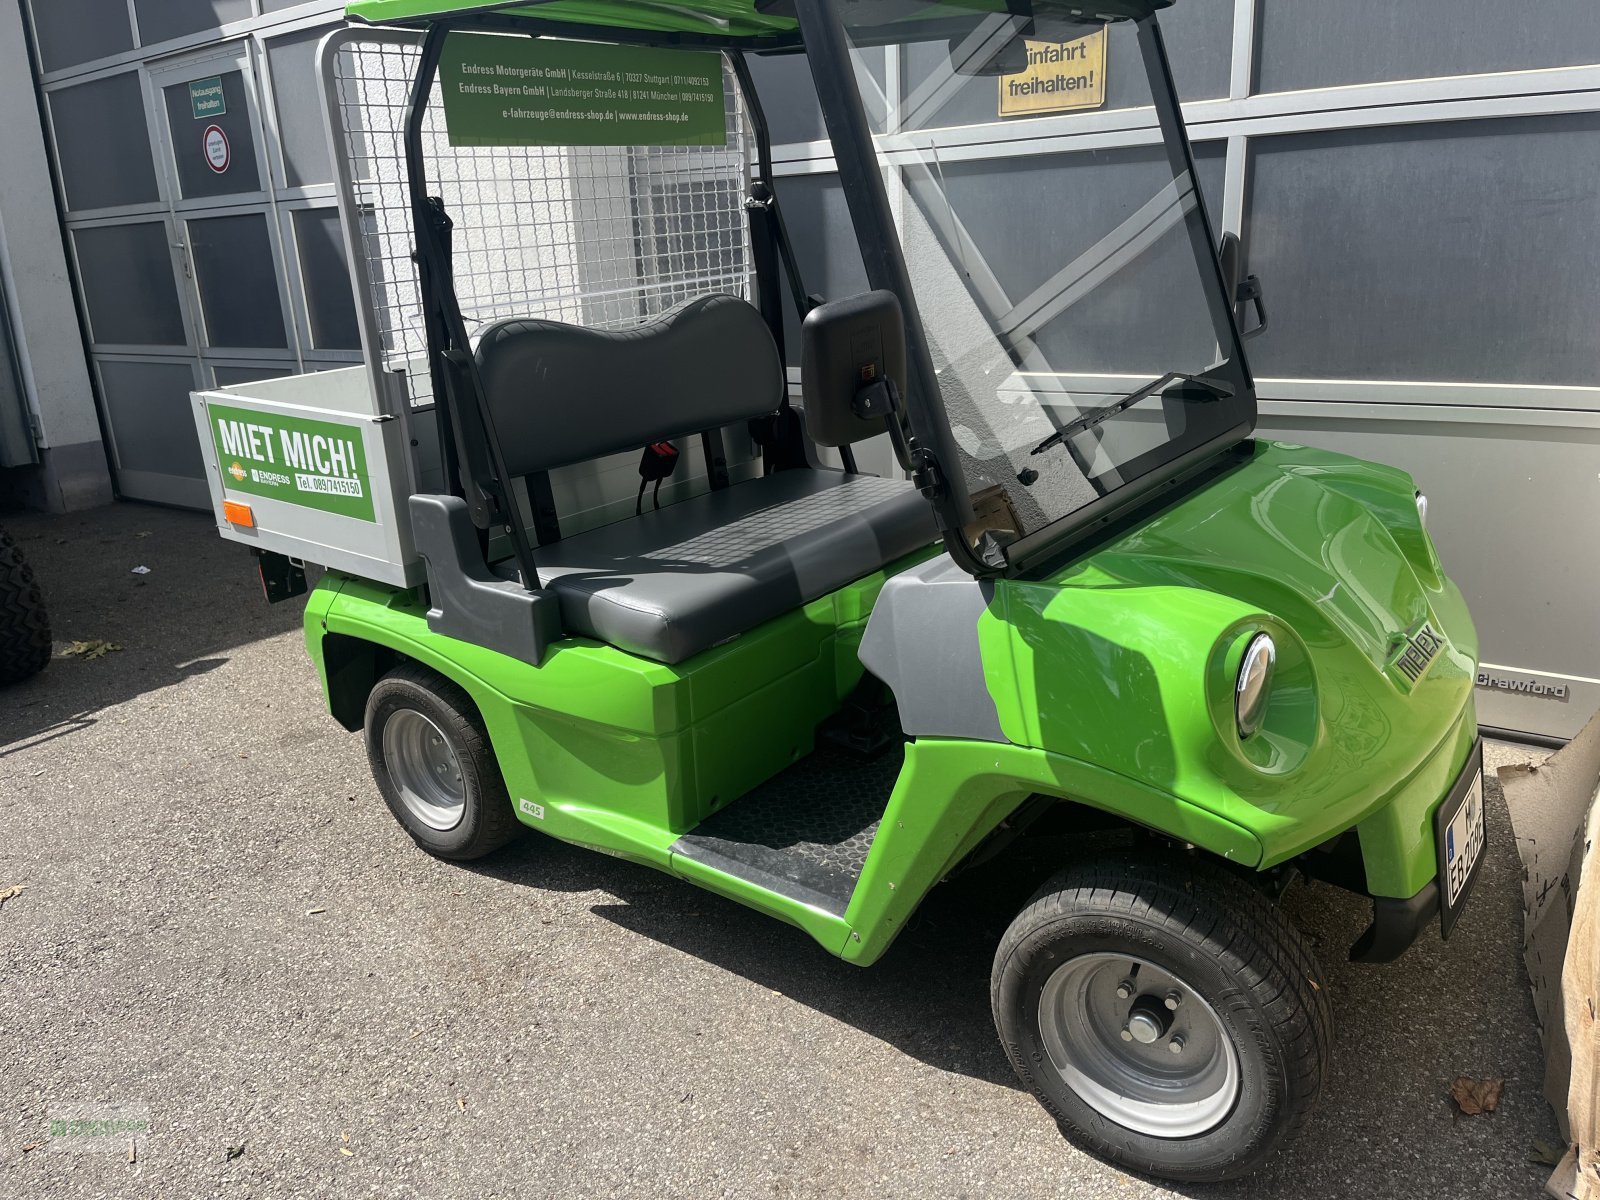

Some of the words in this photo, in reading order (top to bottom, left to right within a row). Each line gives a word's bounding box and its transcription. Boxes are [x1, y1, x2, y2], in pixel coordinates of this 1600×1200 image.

[1027, 42, 1086, 65] infahrt
[462, 63, 494, 75] Endress
[496, 65, 543, 78] Motorgeräte
[545, 68, 566, 78] GmbH
[572, 69, 615, 81] Kesselstraße
[616, 72, 621, 82] 6
[625, 73, 642, 83] 70327
[644, 74, 670, 85] Stuttgart
[1009, 71, 1094, 96] freihalten!
[459, 82, 491, 94] Endress
[493, 84, 520, 96] Bayern
[523, 85, 545, 96] GmbH
[551, 86, 593, 99] Landsberger
[594, 88, 616, 99] Straße
[617, 89, 628, 99] 418
[633, 90, 649, 100] 81241
[650, 91, 678, 101] München
[502, 108, 613, 122] e-fahrzeuge@endress-shop.de
[619, 112, 689, 123] www.endress-shop.de
[218, 418, 275, 464] MIET
[279, 429, 358, 480] MICH!
[258, 470, 291, 485] ENDRESS
[298, 476, 313, 489] Tel.
[314, 478, 360, 495] 089/7415150
[1476, 672, 1568, 698] Crawford
[523, 802, 541, 816] 445
[1450, 854, 1464, 898] EB
